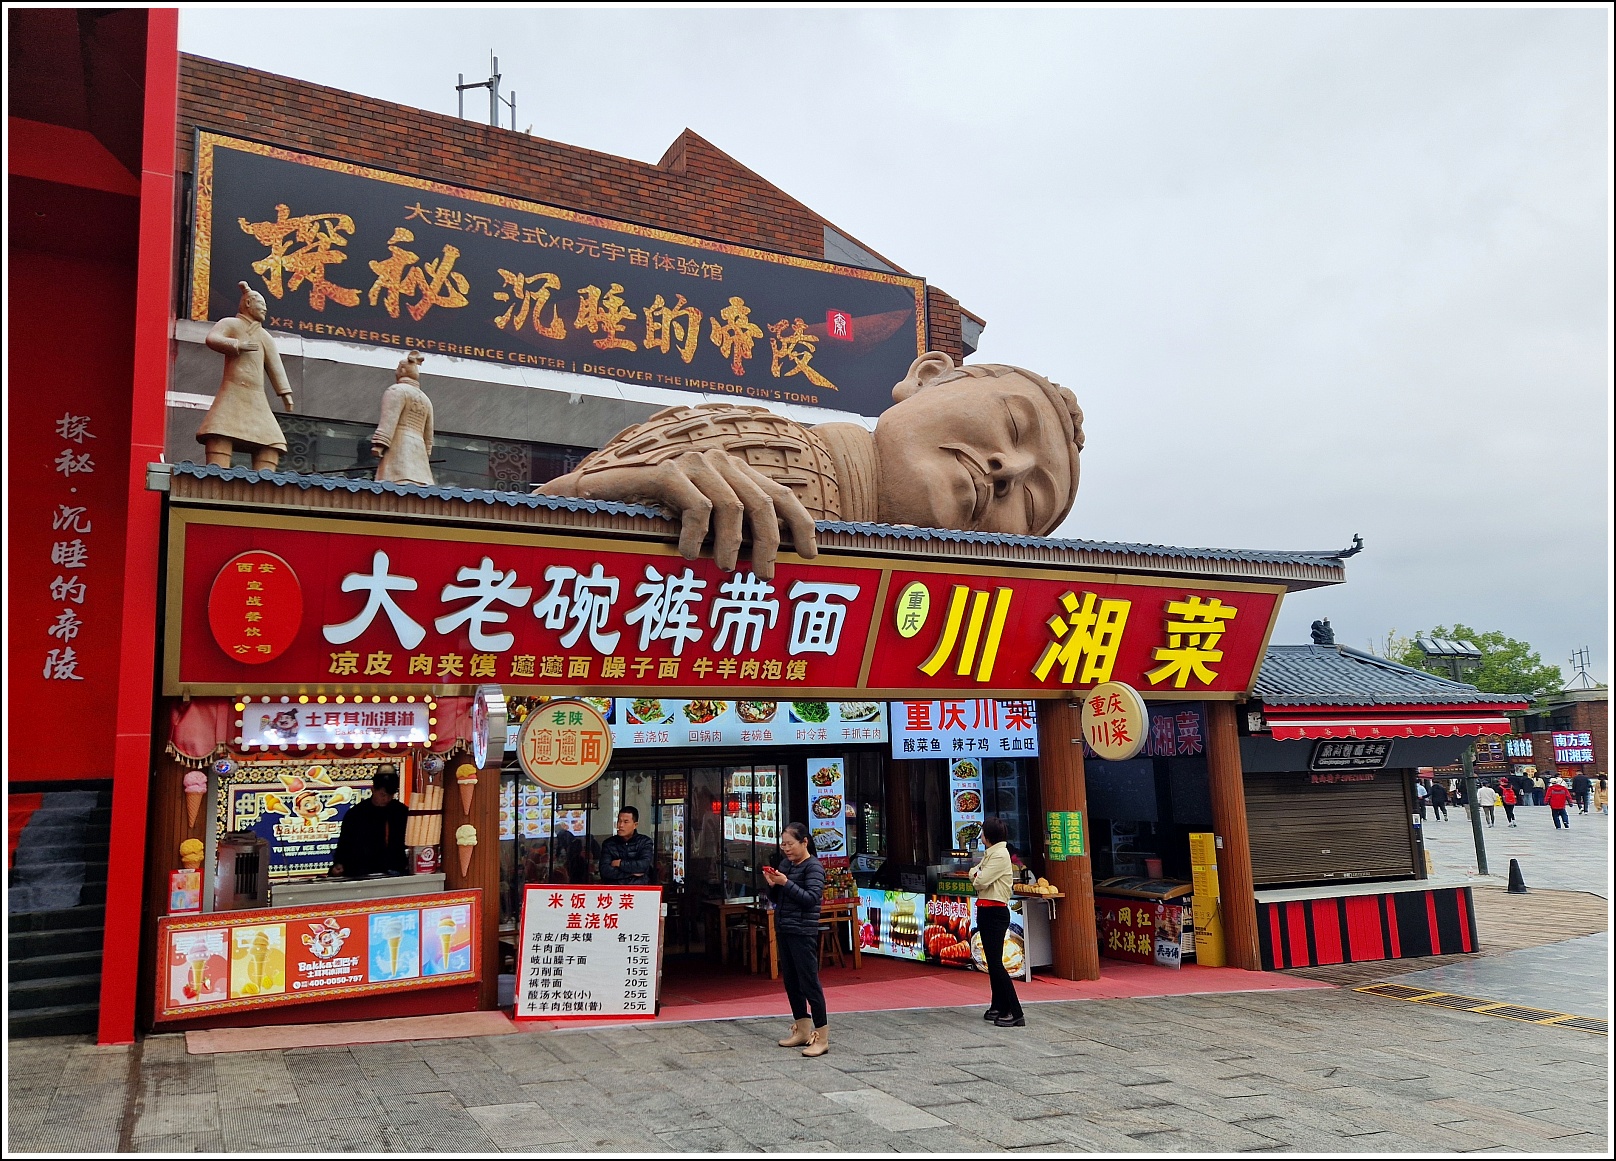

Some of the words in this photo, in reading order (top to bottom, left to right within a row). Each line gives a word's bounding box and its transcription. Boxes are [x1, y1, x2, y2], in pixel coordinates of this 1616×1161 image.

[404, 202, 723, 282] 大型沉浸式XR元宇宙体验馆
[237, 203, 470, 321] 探秘
[493, 268, 839, 392] 沉睡的帝陵
[270, 317, 294, 330] XR
[299, 320, 400, 346] METAVERSE
[405, 336, 504, 361] EXPERIENCE
[508, 352, 566, 369] CENTER
[583, 363, 654, 382] DISCOVER
[656, 373, 682, 387] THE
[685, 377, 744, 395] IMPEROR
[784, 392, 819, 405] TOMB
[236, 563, 277, 574] 西安
[322, 548, 861, 656] 大老碗裤带面
[901, 590, 926, 632] 重庆
[917, 584, 1239, 688] 川湘菜
[233, 644, 272, 654] 公司
[328, 650, 393, 676] 凉皮
[408, 653, 497, 678] 肉夹馍
[600, 656, 681, 679] 臊子面
[692, 655, 809, 681] 牛羊肉泡馍
[1088, 692, 1127, 718] 重庆
[305, 711, 415, 727] 土耳其冰淇淋
[551, 710, 584, 726] 老陕
[902, 699, 1033, 732] 重庆川菜
[633, 730, 669, 743] 盖浇饭
[688, 730, 722, 743] 回锅肉
[740, 728, 773, 742] 老碗鱼
[796, 728, 828, 741] 时令菜
[841, 727, 881, 740] 手抓羊肉
[1091, 717, 1134, 747] 川菜
[1555, 733, 1592, 747] 南方菜
[903, 737, 942, 752] 酸菜鱼
[952, 737, 990, 751] 辣子鸡
[999, 737, 1036, 751] 毛血旺
[1556, 748, 1594, 763] 川湘菜
[938, 881, 975, 893] 肉多多烤肠
[548, 893, 586, 909] 米饭
[597, 893, 635, 910] 炒菜
[927, 900, 968, 918] 肉多肉烤肠
[566, 913, 619, 929] 盖浇饭
[1118, 907, 1152, 928] 网红
[532, 933, 593, 943] 凉皮/肉夹馍
[617, 933, 650, 943] 各12元
[1108, 928, 1152, 956] 冰淇淋
[531, 944, 565, 954] 牛肉面
[627, 945, 650, 954] 15元
[1156, 944, 1179, 959] 兵马俑
[626, 956, 649, 965] 15元
[530, 967, 563, 977] 刀削面
[626, 967, 649, 977] 15元
[309, 975, 363, 987] 400-0050-797
[528, 979, 563, 989] 裤带面
[624, 979, 648, 988] 20元
[527, 990, 592, 1001] 酸汤水饺(小)
[623, 990, 648, 999] 25元
[526, 1001, 602, 1012] 牛羊肉泡馍(普)
[622, 1001, 647, 1011] 25元
